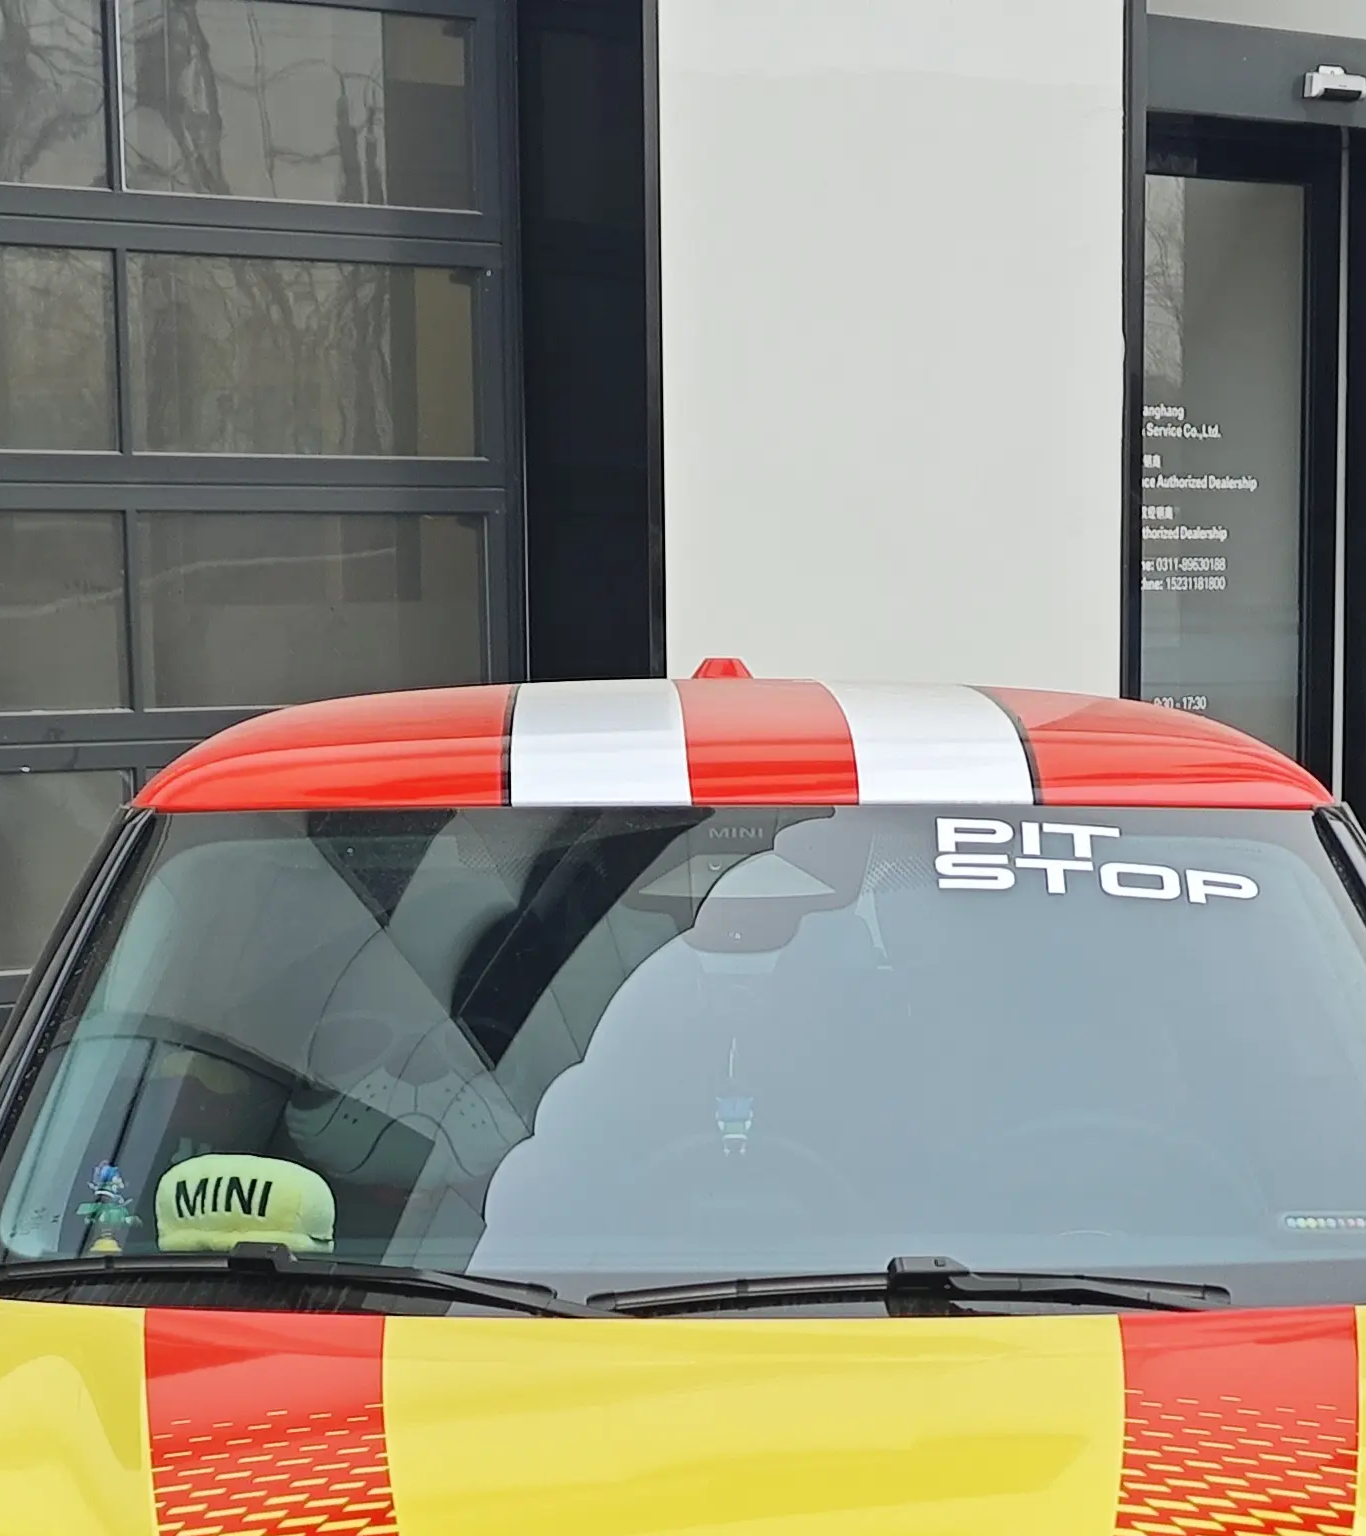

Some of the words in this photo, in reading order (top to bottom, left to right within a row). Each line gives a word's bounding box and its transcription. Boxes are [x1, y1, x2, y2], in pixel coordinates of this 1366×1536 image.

[1146, 422, 1182, 438] Service
[1156, 474, 1208, 489] Authorized
[1208, 475, 1258, 491] Dealership
[1180, 526, 1228, 541] Dealership
[1182, 695, 1208, 710] 17:30
[708, 827, 765, 840] MINI
[936, 816, 1122, 859] PIT
[934, 853, 1260, 904] STOP
[174, 1176, 274, 1219] MINI
